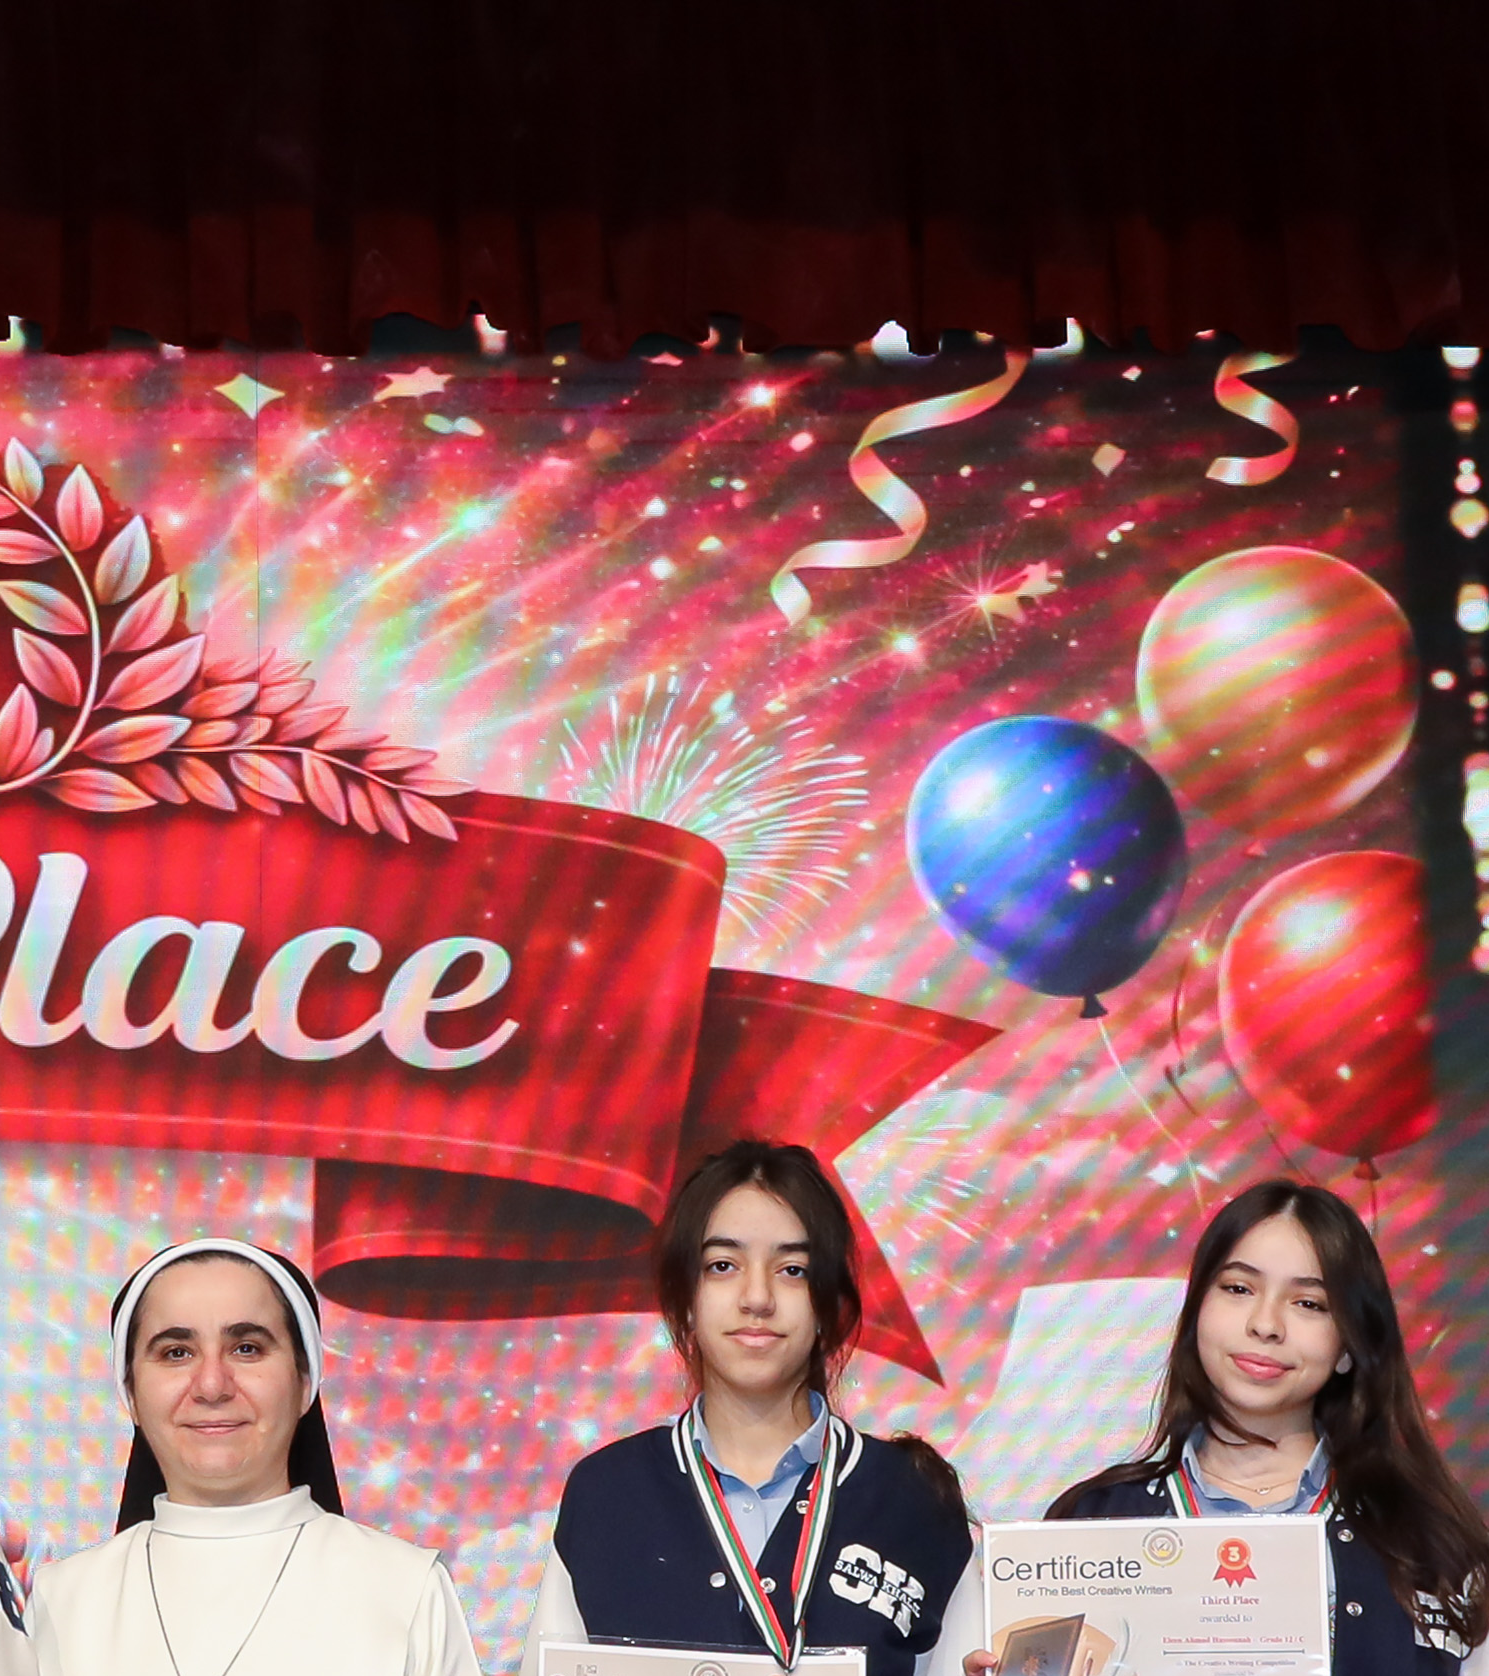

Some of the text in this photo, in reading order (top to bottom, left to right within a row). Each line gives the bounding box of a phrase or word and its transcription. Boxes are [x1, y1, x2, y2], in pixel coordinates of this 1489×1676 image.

[1227, 1546, 1240, 1562] 3
[834, 1560, 878, 1588] SALWA
[992, 1555, 1142, 1582] Certificate
[1017, 1584, 1173, 1597] For The Best Creative Writers
[1201, 1596, 1259, 1605] Third Place
[1200, 1614, 1252, 1623] awarded to
